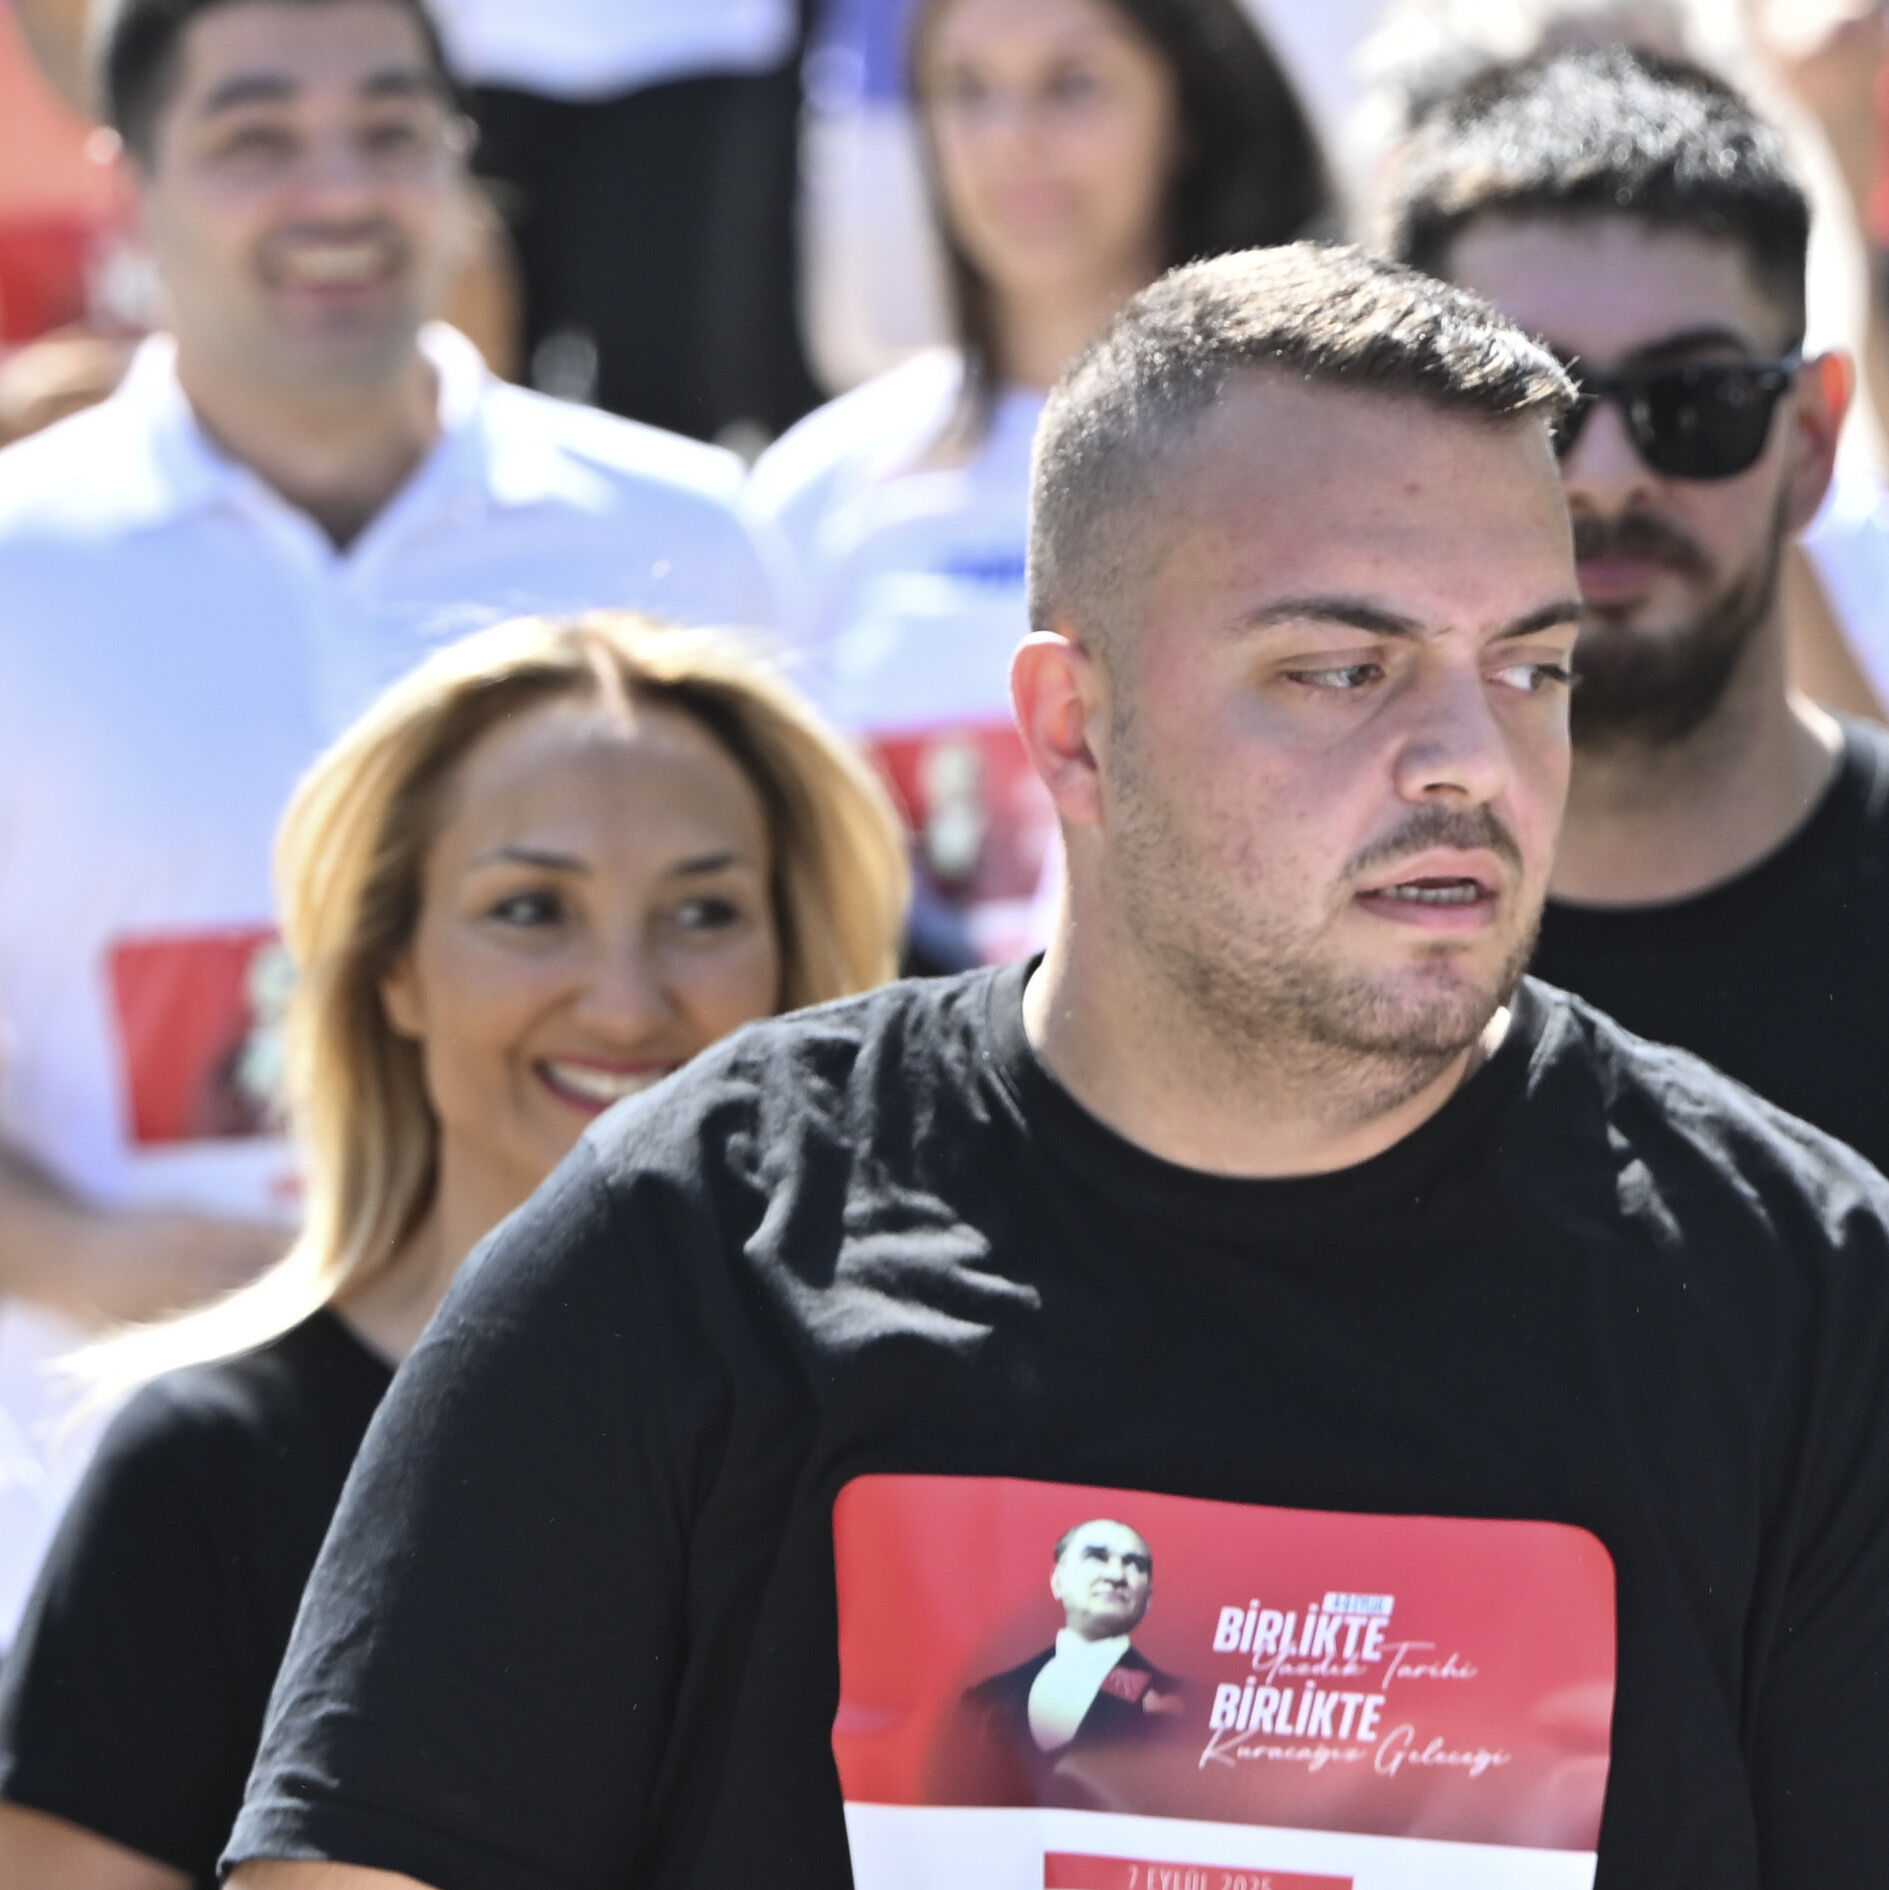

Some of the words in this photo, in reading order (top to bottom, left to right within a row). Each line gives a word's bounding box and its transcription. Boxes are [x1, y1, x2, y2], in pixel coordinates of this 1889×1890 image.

[1213, 1598, 1390, 1662] BİRLİKTE
[1209, 1675, 1387, 1742] BİRLİKTE
[1127, 1865, 1139, 1890] 7
